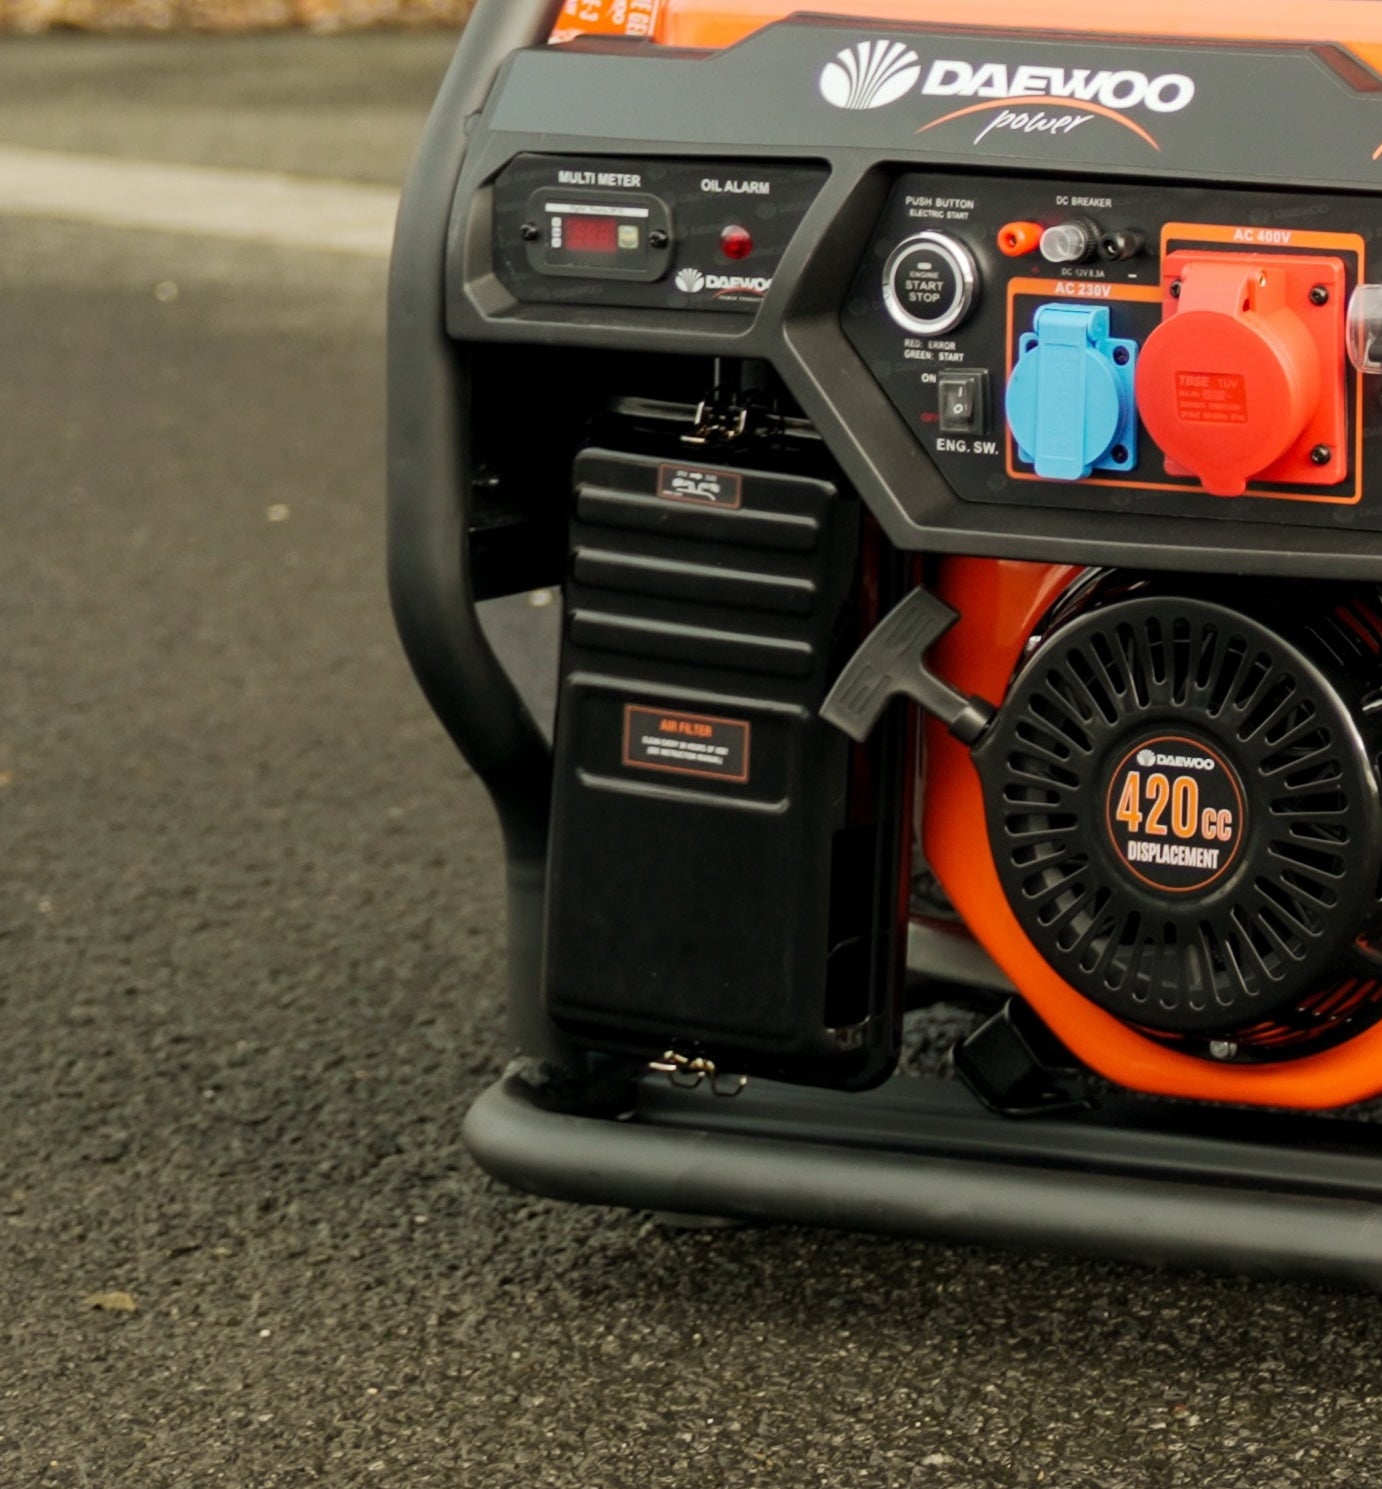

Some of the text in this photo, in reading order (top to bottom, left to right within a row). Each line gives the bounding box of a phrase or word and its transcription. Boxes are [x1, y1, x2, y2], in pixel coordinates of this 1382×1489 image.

[922, 59, 1195, 112] DAEWOO
[974, 107, 1095, 145] power
[558, 170, 642, 188] MULTI METER
[700, 178, 770, 195] OIL ALARM
[905, 195, 975, 209] PUSH BUTTON
[1055, 195, 1112, 208] DC BREAKER
[909, 208, 969, 220] ELECTRIC START
[1233, 228, 1292, 244] AC 400V
[909, 270, 940, 280] ENGINE
[904, 280, 944, 292] START
[1055, 281, 1112, 297] AC 230V
[908, 292, 941, 303] STOP
[904, 338, 956, 351] RED: ERROR
[904, 349, 965, 363] GREEN: START
[921, 373, 937, 384] ON
[936, 438, 999, 455] ENG. SW.
[659, 719, 713, 738] AIR FILTER
[1156, 753, 1216, 771] DAEWOO
[1127, 840, 1220, 870] DISPLACEMENT
